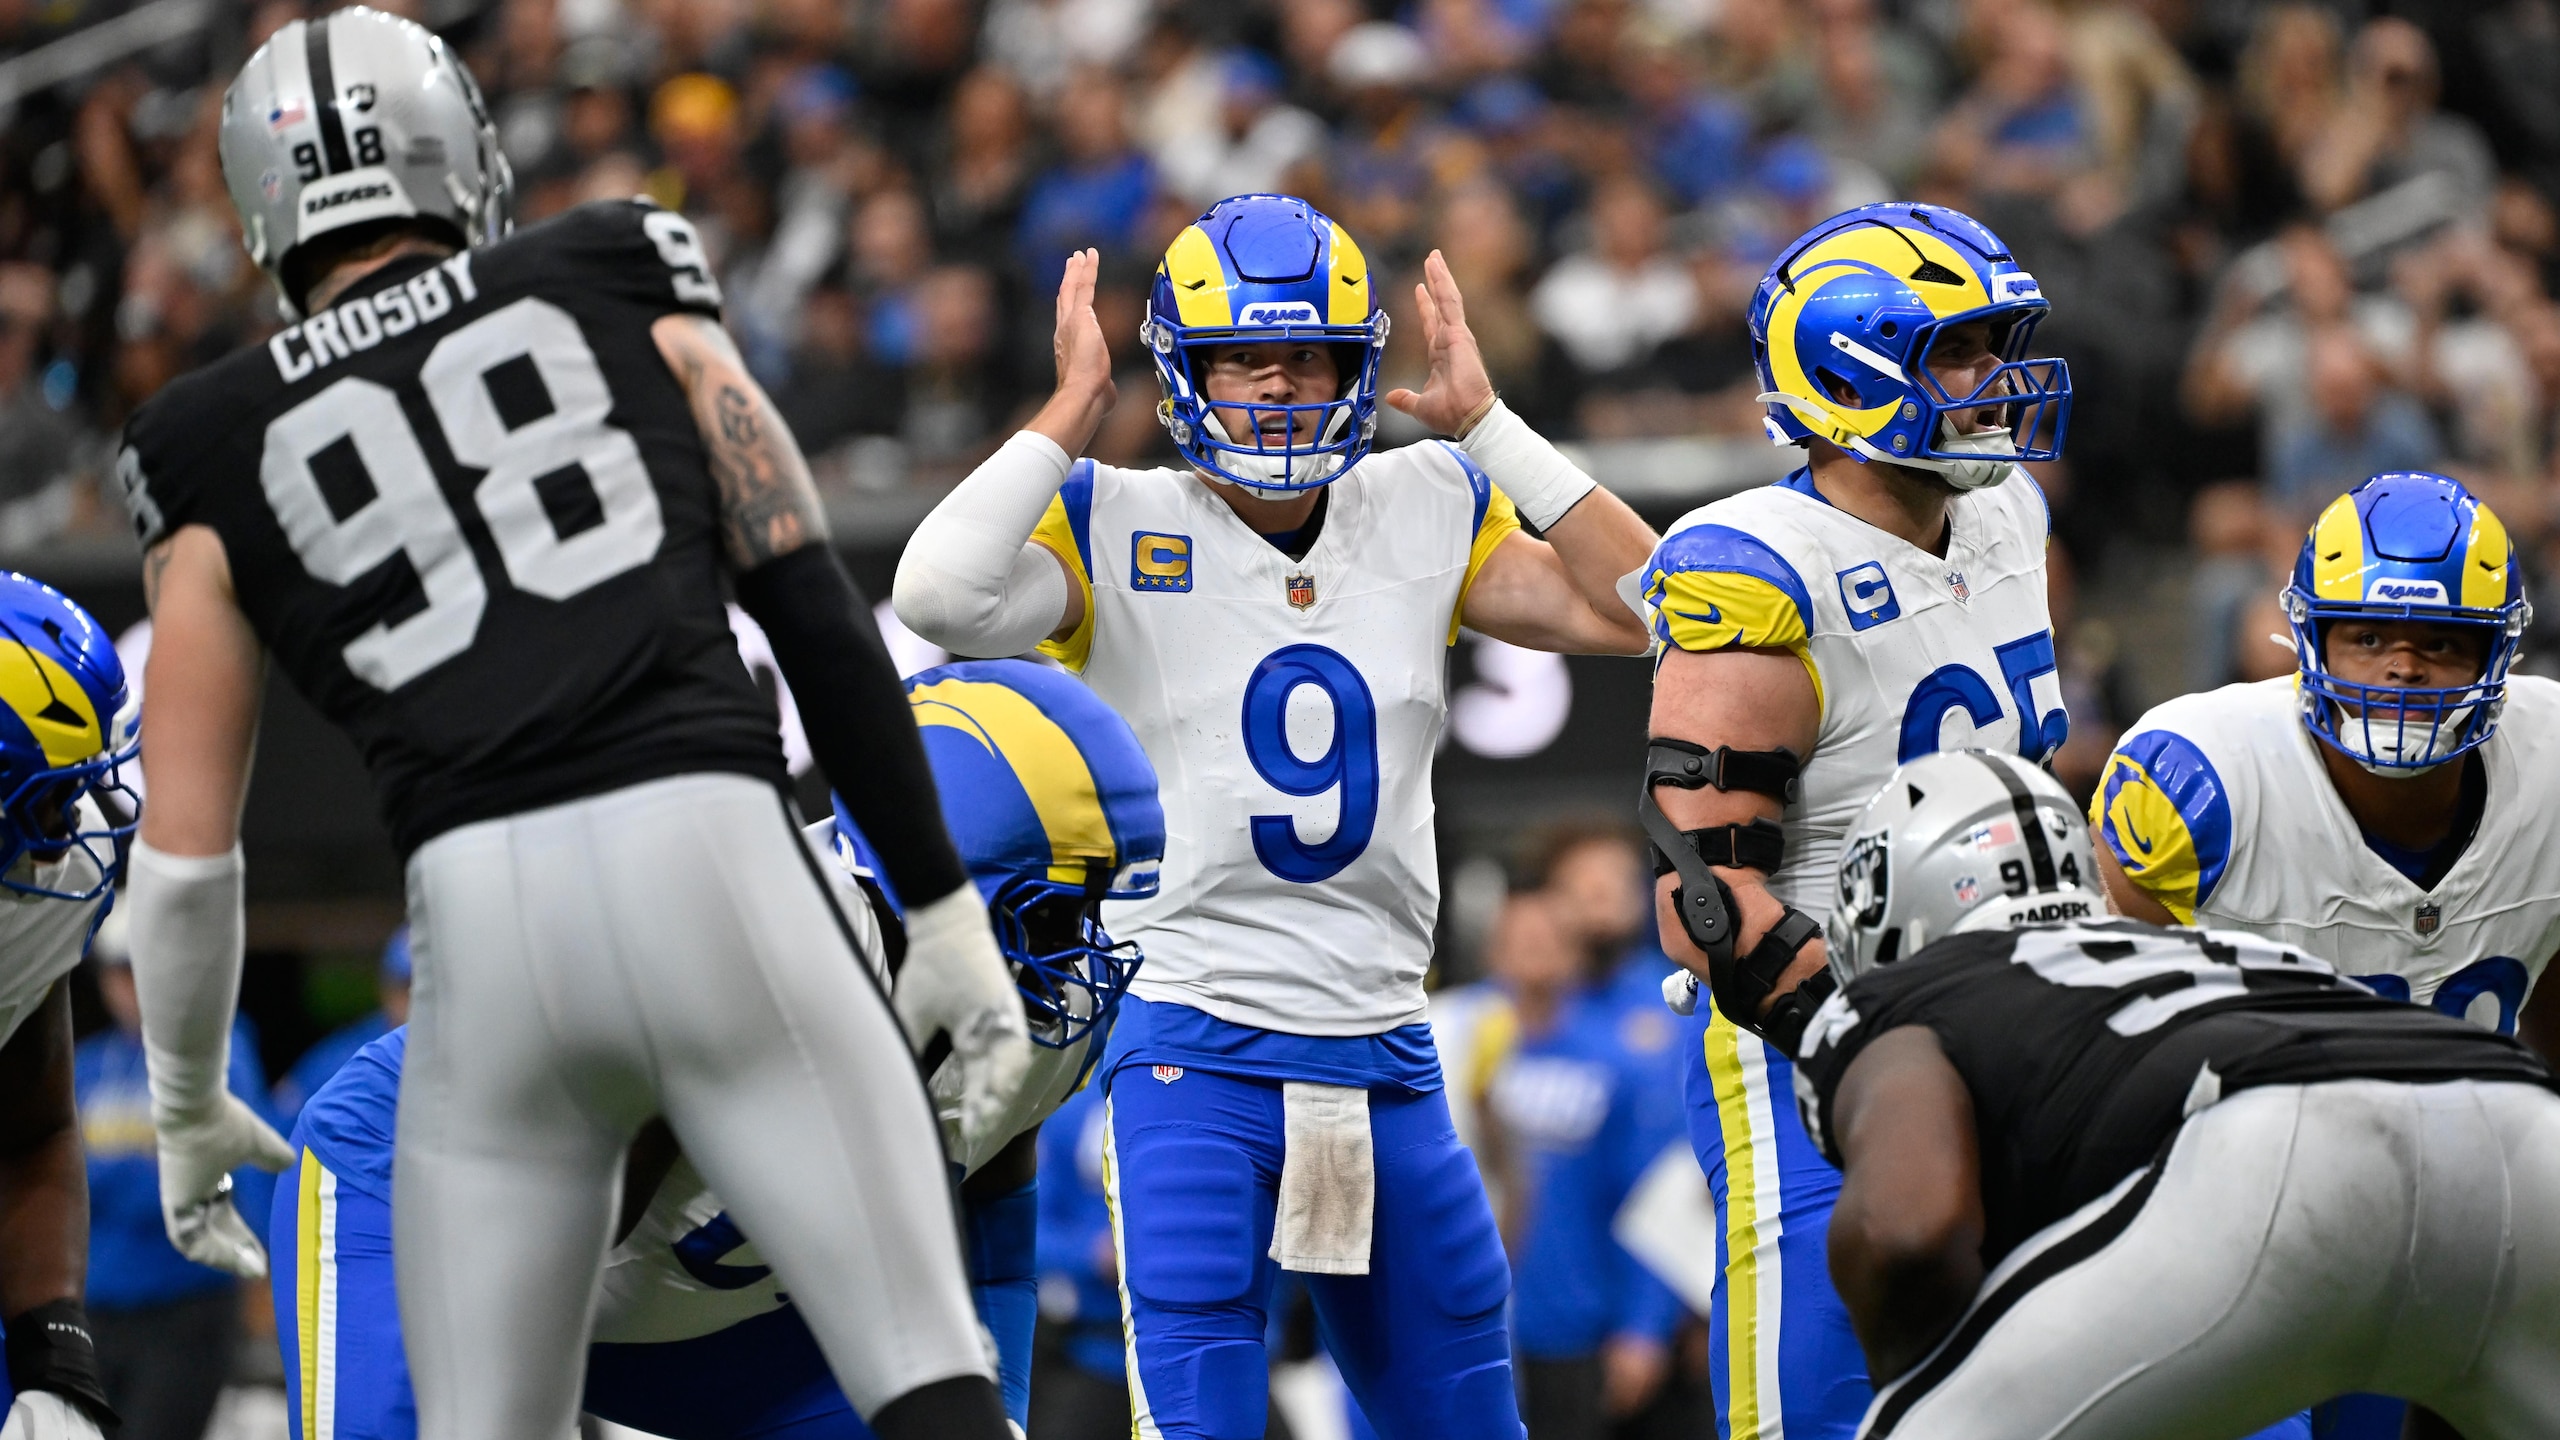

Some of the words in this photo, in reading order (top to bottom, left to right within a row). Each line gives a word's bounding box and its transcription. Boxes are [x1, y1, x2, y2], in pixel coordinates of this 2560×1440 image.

[306, 184, 393, 214] RAIDERS
[269, 250, 478, 384] CROSBY
[1249, 309, 1311, 324] RAMS
[260, 298, 664, 692] 98
[1136, 535, 1188, 577] C
[1291, 589, 1312, 604] NFL
[1841, 566, 1890, 614] C
[2378, 584, 2439, 599] RAMS
[1242, 643, 1379, 883] 9
[2010, 902, 2091, 924] RAIDERS
[1157, 1065, 1179, 1077] NFL
